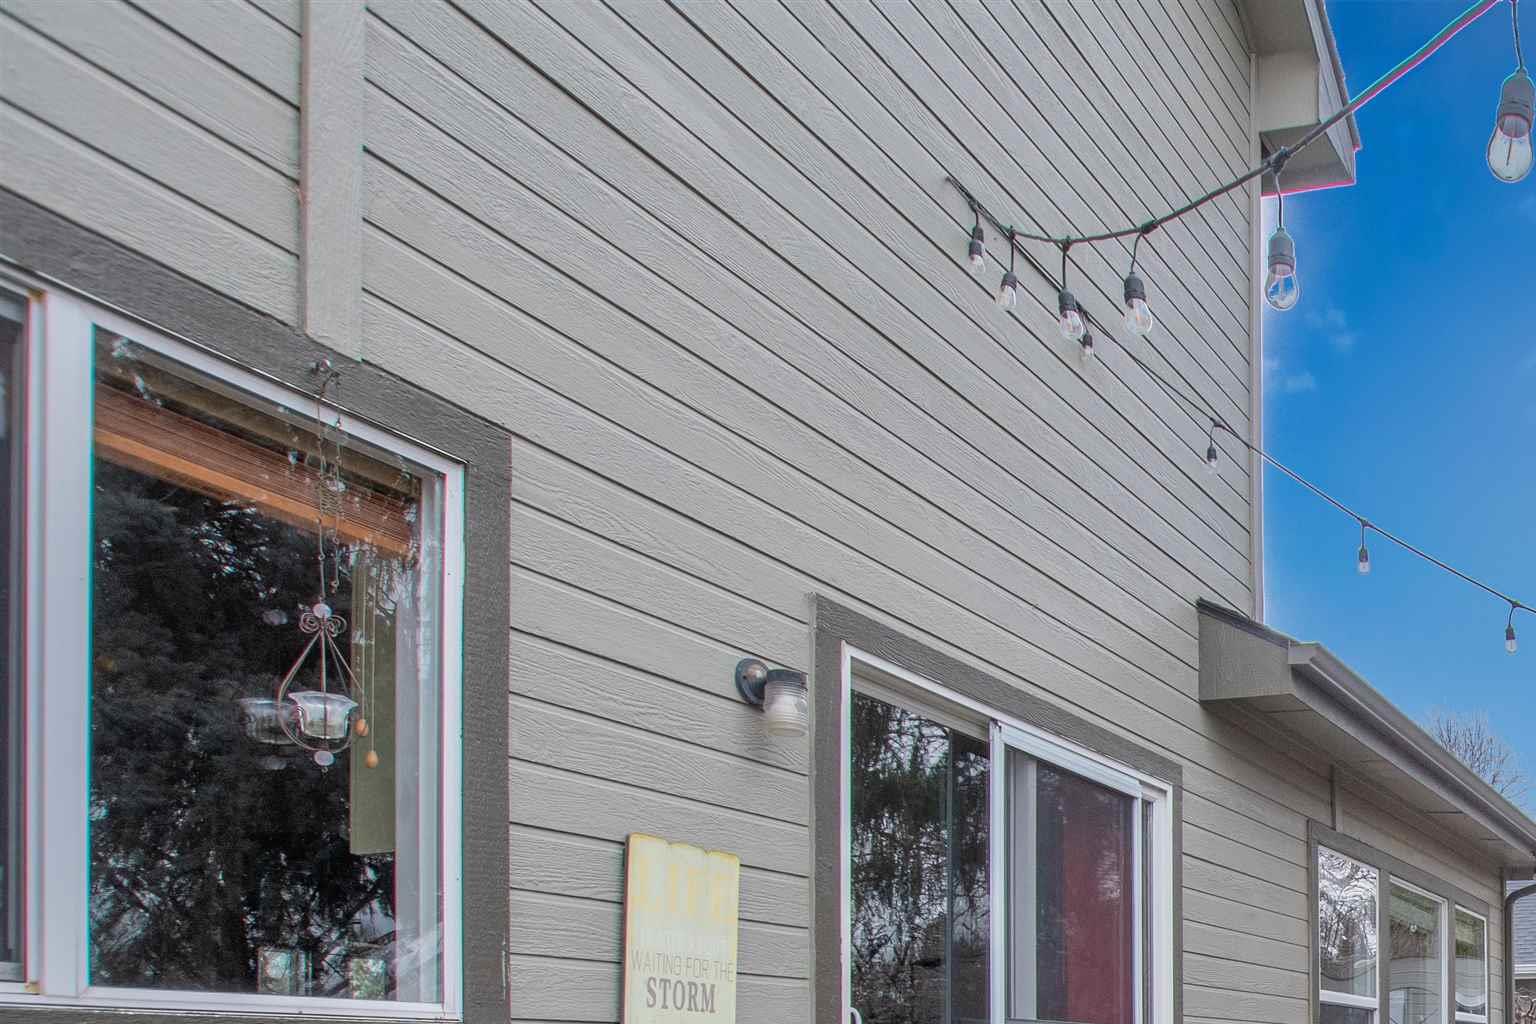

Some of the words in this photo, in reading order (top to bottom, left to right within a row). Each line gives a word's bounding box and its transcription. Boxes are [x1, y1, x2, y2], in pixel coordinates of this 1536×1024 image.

[631, 949, 681, 977] WAITING
[686, 956, 711, 980] FOR
[713, 959, 735, 983] THE
[646, 976, 716, 1014] STORM
